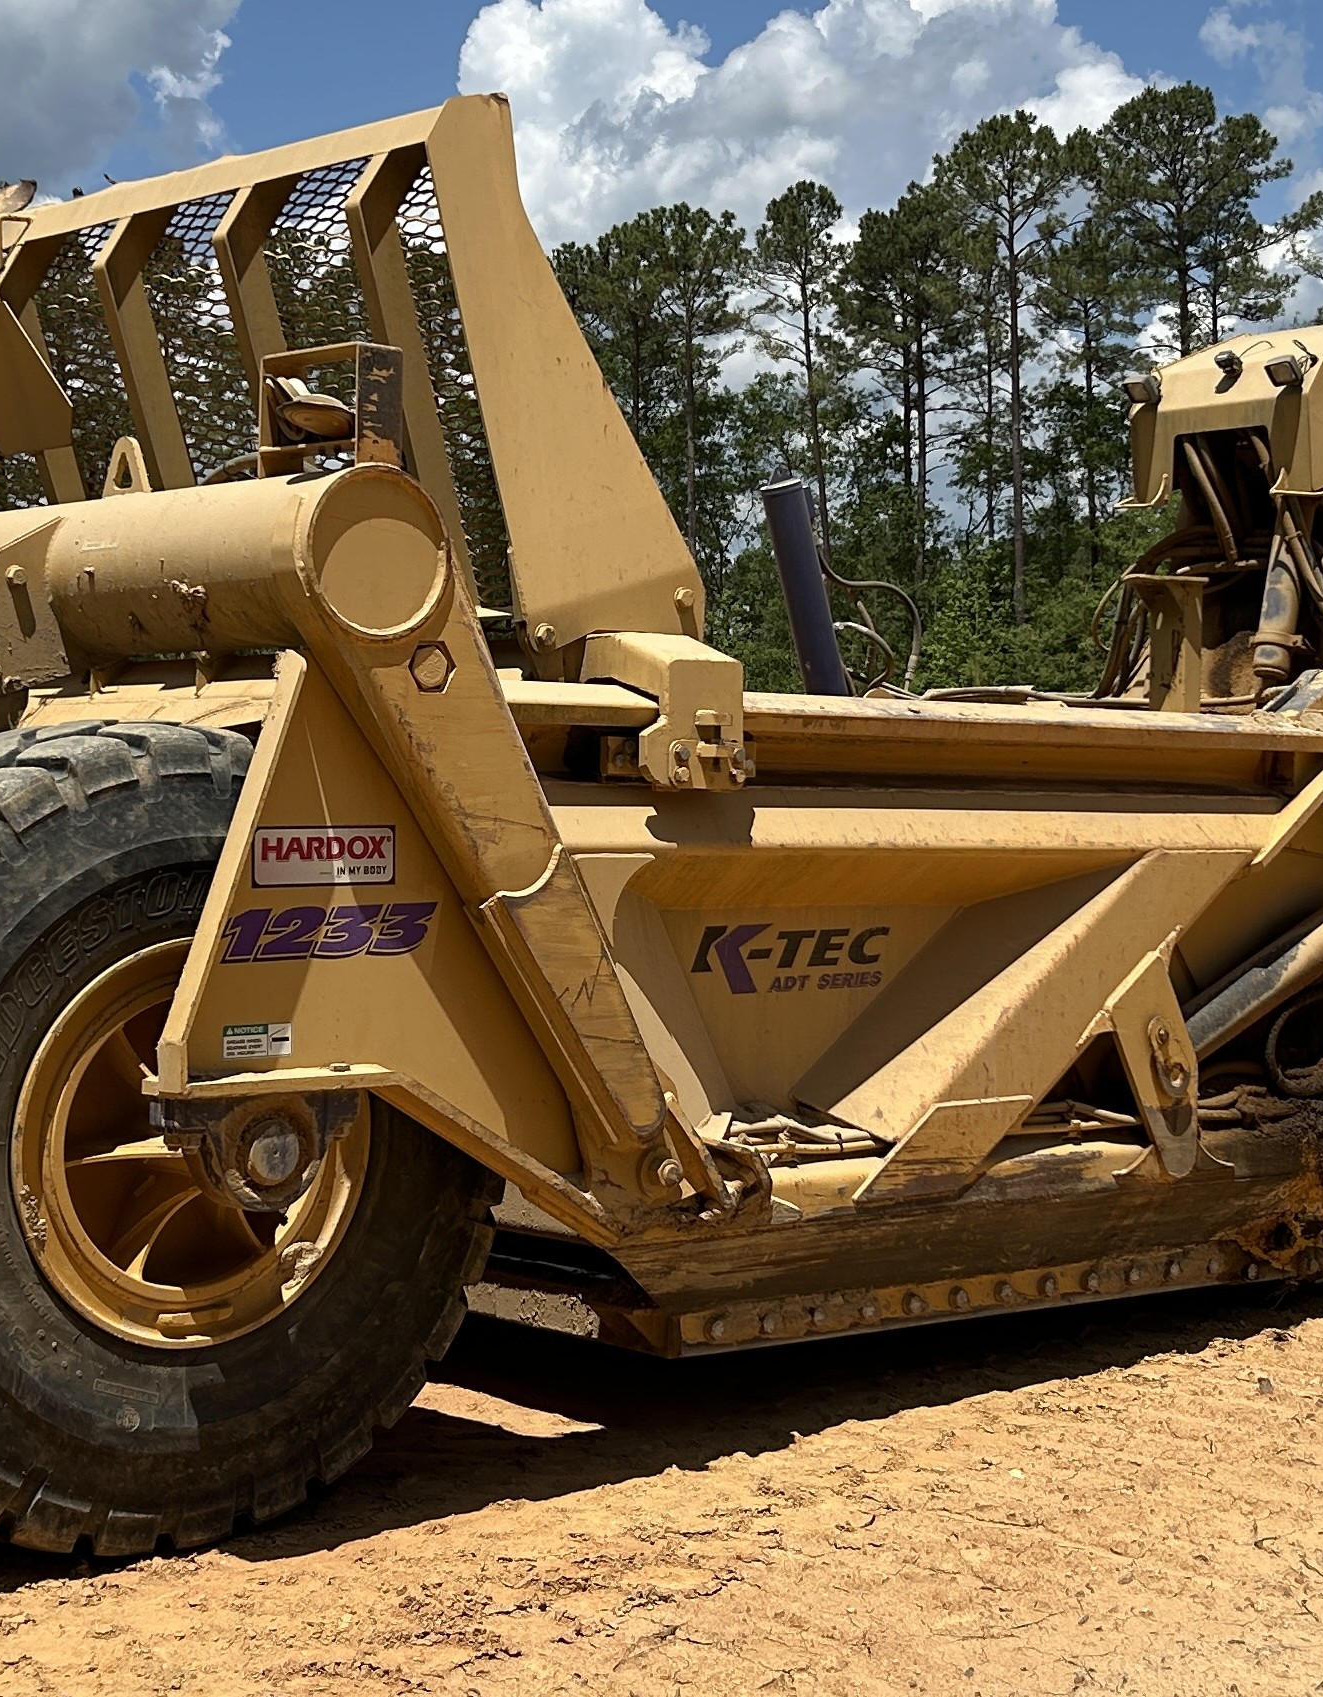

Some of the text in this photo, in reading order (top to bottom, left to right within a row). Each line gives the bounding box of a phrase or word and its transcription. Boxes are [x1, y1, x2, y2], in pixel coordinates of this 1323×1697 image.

[337, 865, 387, 875] IN MY BODY
[220, 902, 438, 964] 1233
[690, 923, 891, 994] K-TEC
[767, 970, 883, 993] ADT SERIES
